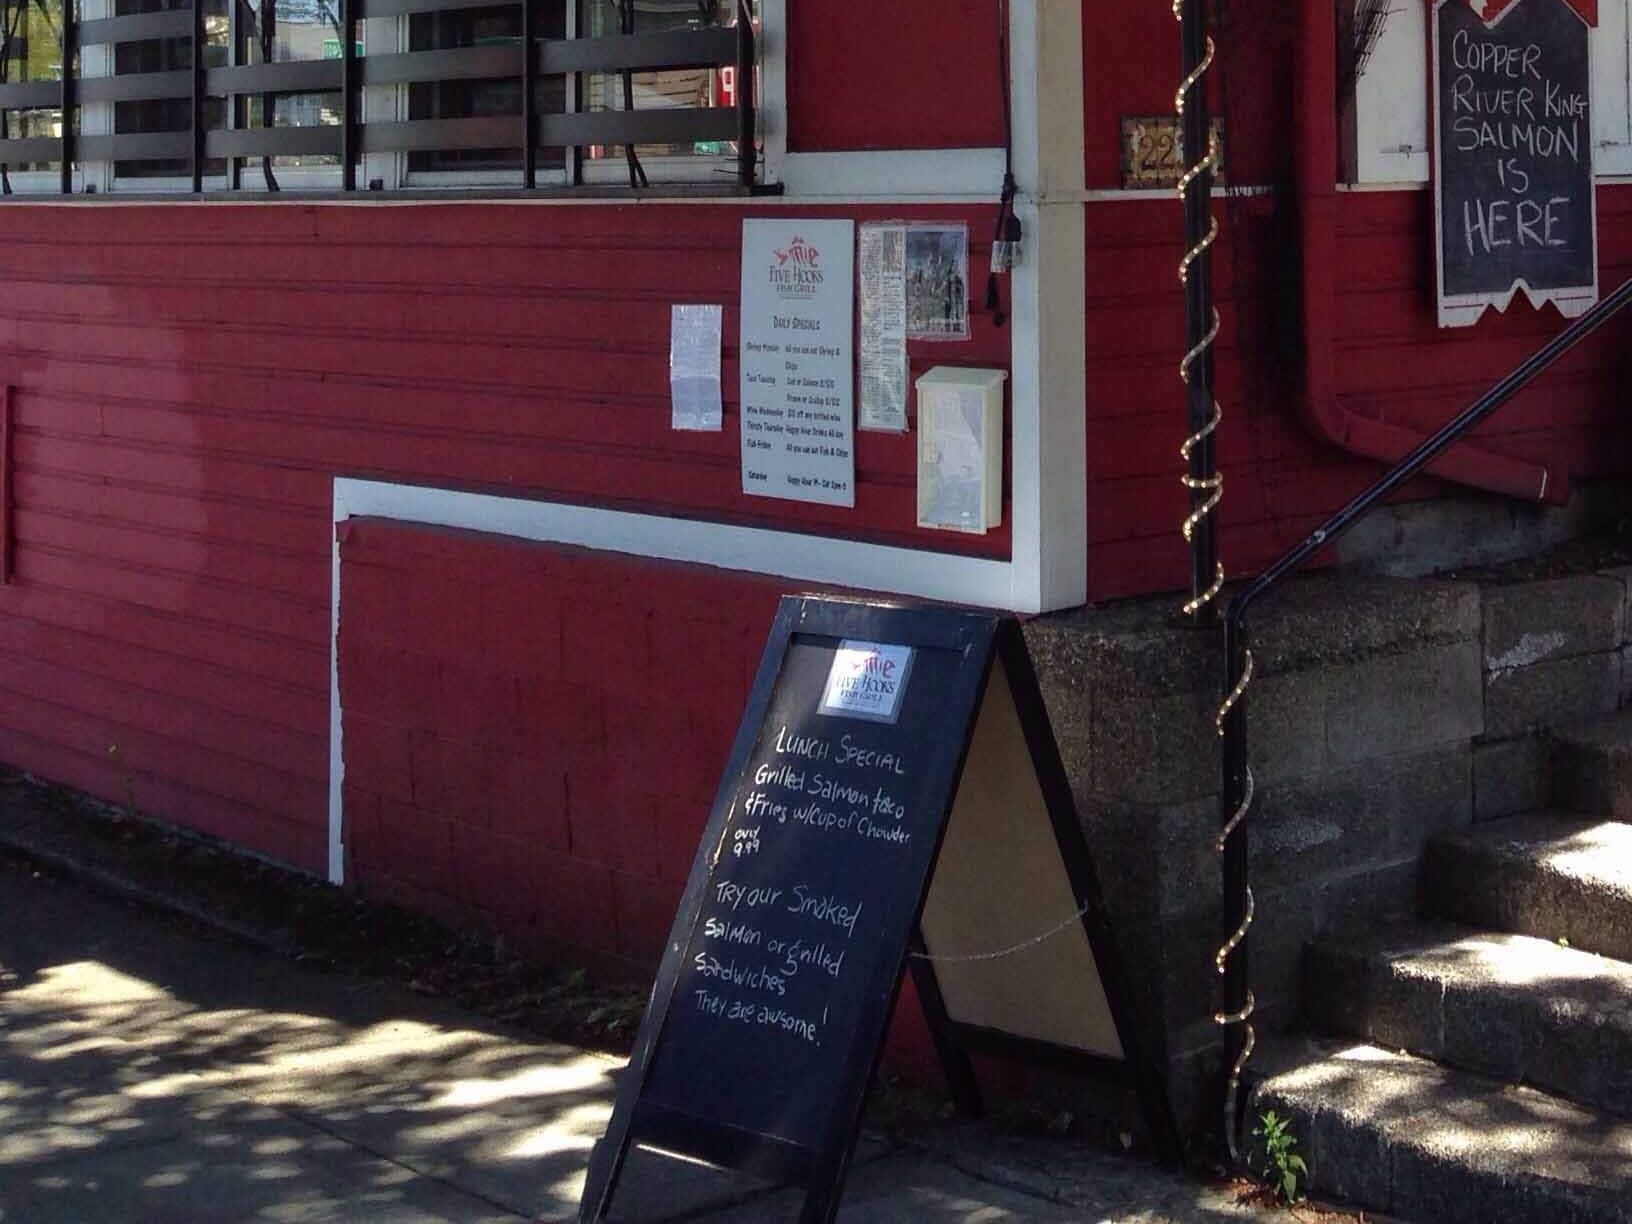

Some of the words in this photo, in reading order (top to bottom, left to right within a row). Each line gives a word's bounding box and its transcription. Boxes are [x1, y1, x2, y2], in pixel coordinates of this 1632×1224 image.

[1452, 29, 1542, 80] COPPER
[1452, 76, 1536, 116] RIVER
[1544, 79, 1590, 118] KING
[1455, 116, 1579, 161] SALMON
[1498, 158, 1530, 194] IS
[1463, 197, 1571, 257] HERE
[775, 725, 830, 760] LUNCH
[835, 734, 905, 775] SPECIAL
[754, 763, 806, 792] Grilled
[807, 773, 869, 809] Salmon
[857, 816, 911, 845] Chowder
[704, 917, 761, 945] Salmon
[787, 884, 863, 939] Smoked
[695, 989, 725, 1017] They
[727, 1000, 755, 1023] are
